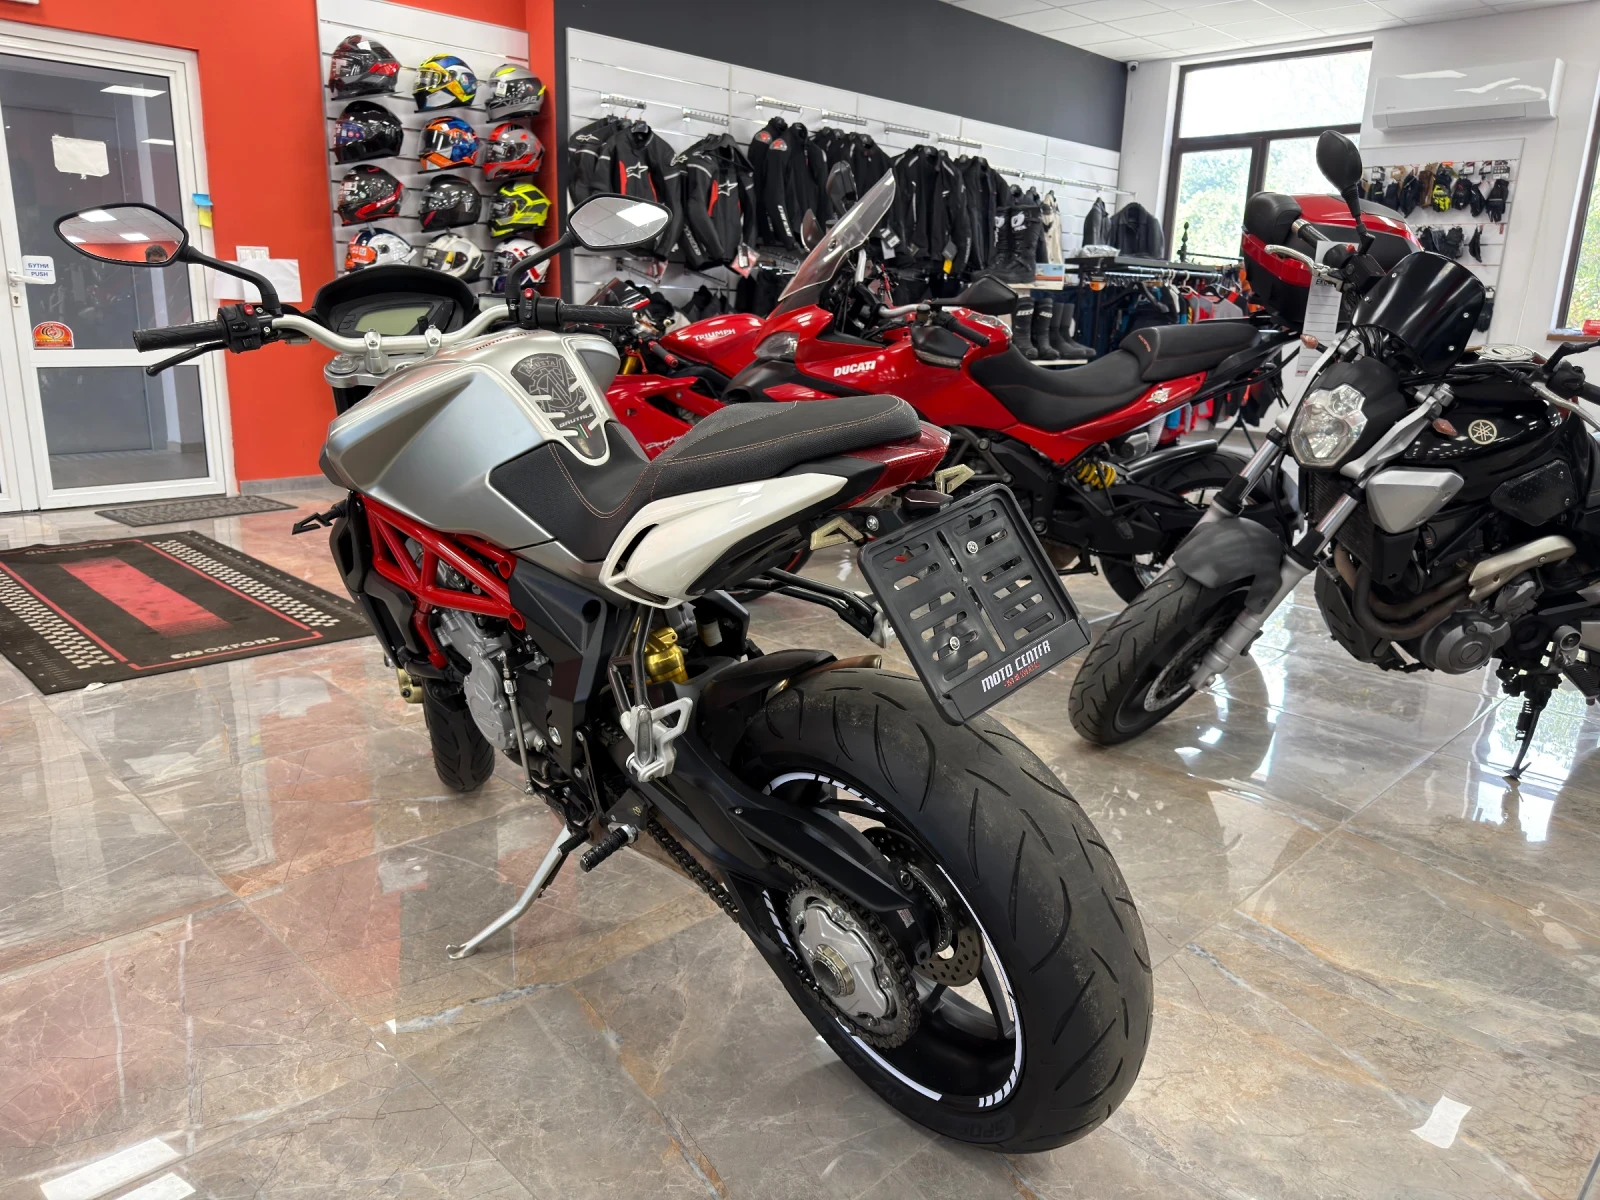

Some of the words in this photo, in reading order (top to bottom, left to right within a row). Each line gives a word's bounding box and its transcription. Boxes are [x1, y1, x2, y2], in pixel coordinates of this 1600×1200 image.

[692, 328, 736, 341] TRIUMPH
[833, 360, 877, 378] DUCATI
[559, 412, 595, 428] BRUTALE
[204, 636, 280, 653] OXFORD
[981, 663, 1014, 693] MOTO
[1014, 640, 1052, 671] CENTER
